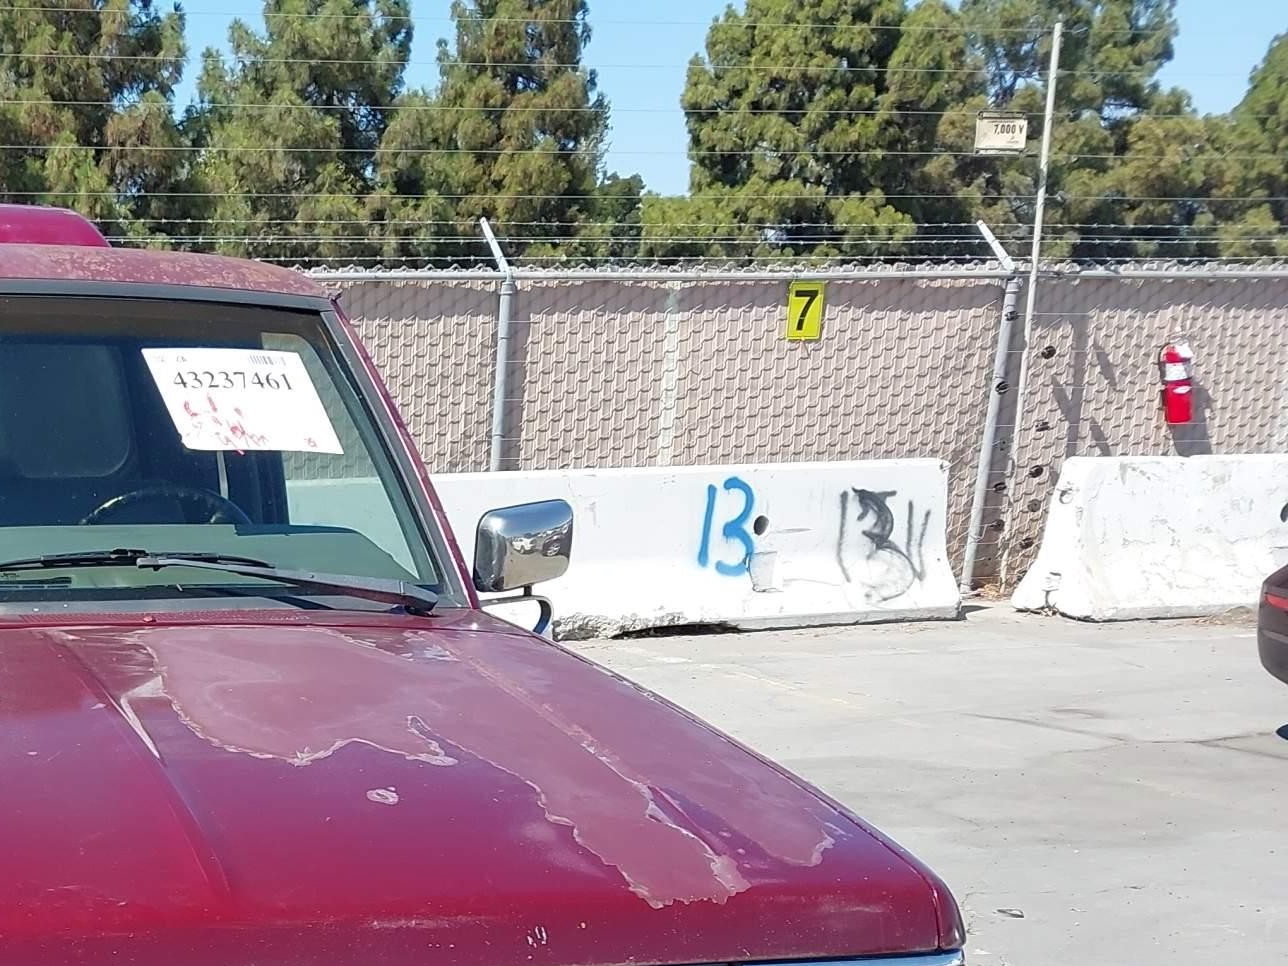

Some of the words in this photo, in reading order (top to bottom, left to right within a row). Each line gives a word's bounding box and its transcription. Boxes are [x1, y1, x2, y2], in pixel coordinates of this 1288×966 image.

[993, 124, 1016, 135] 7,000
[1019, 124, 1024, 134] V
[794, 289, 819, 331] 7
[173, 371, 294, 391] 43237461
[697, 476, 756, 577] 13
